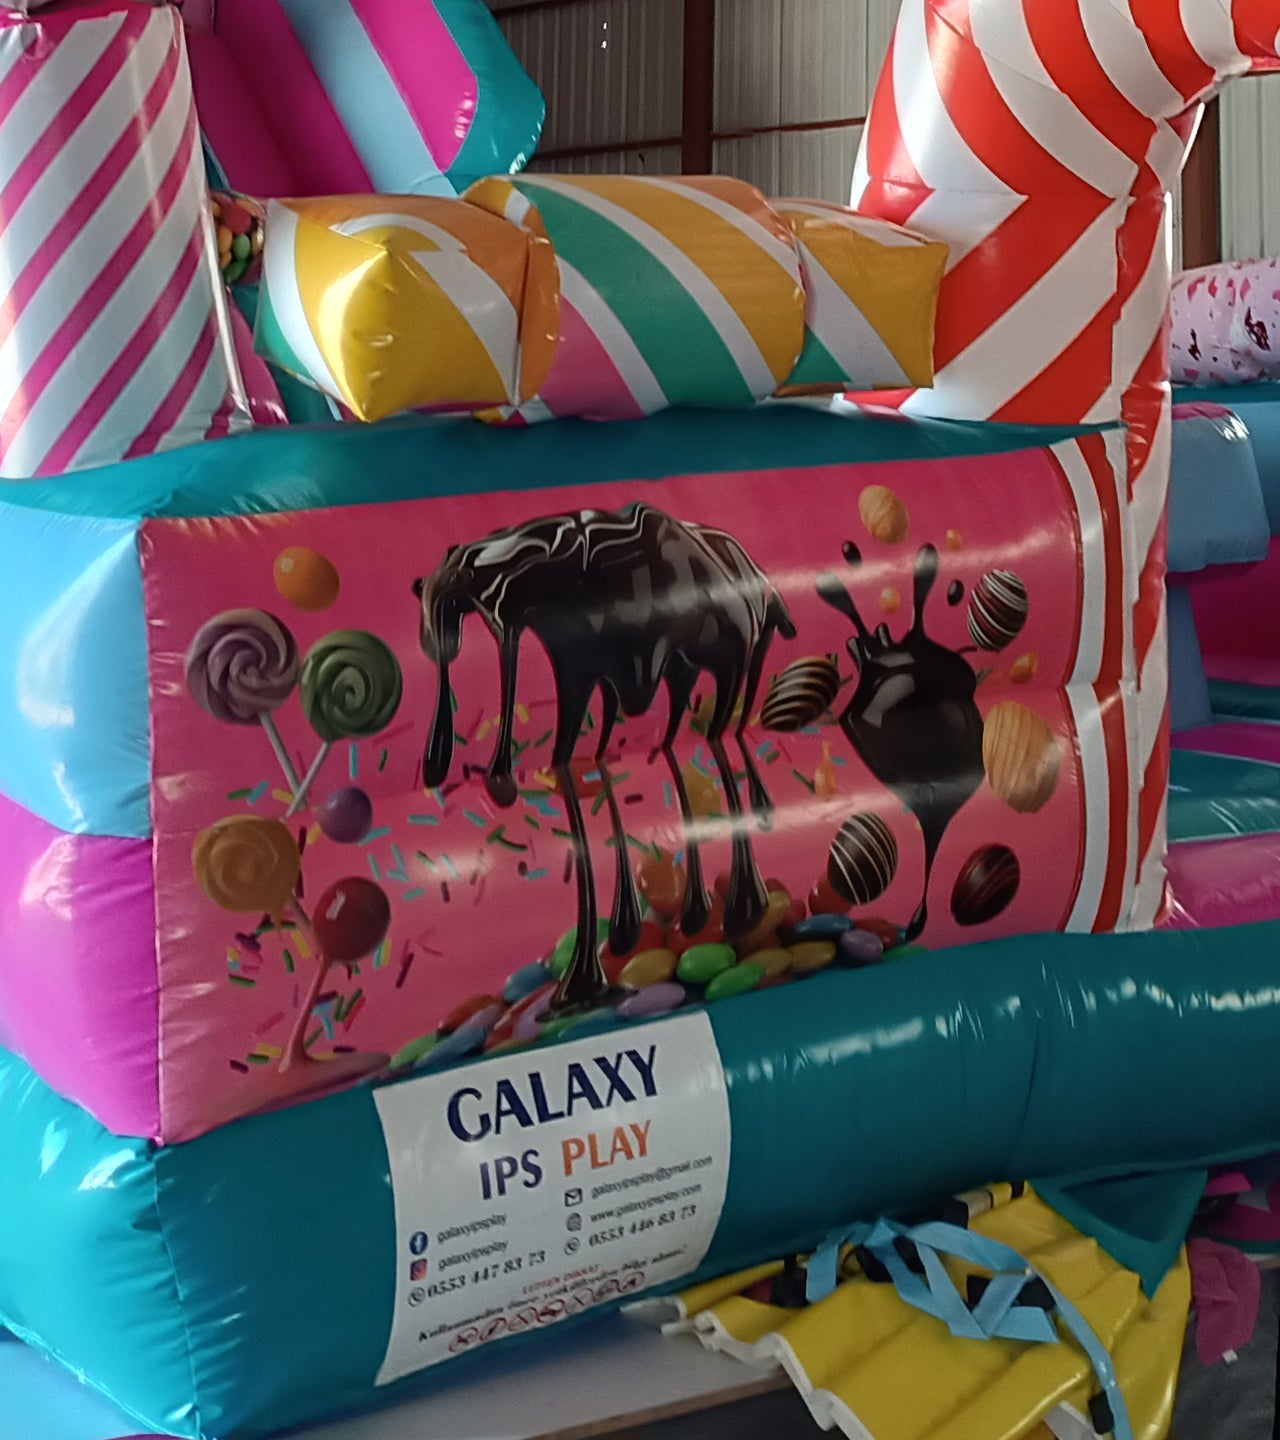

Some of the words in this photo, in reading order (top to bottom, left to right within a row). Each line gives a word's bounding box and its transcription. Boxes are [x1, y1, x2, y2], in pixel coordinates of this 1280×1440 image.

[447, 1045, 658, 1143] GALAXY
[480, 1149, 543, 1201] IPS
[562, 1119, 651, 1177] PLAY
[589, 1226, 625, 1247] 0553
[658, 1210, 676, 1227] 83
[680, 1204, 697, 1220] 73
[427, 1274, 466, 1297] 0553
[471, 1263, 500, 1283] 447
[504, 1257, 522, 1274] 83
[528, 1250, 546, 1266] 73
